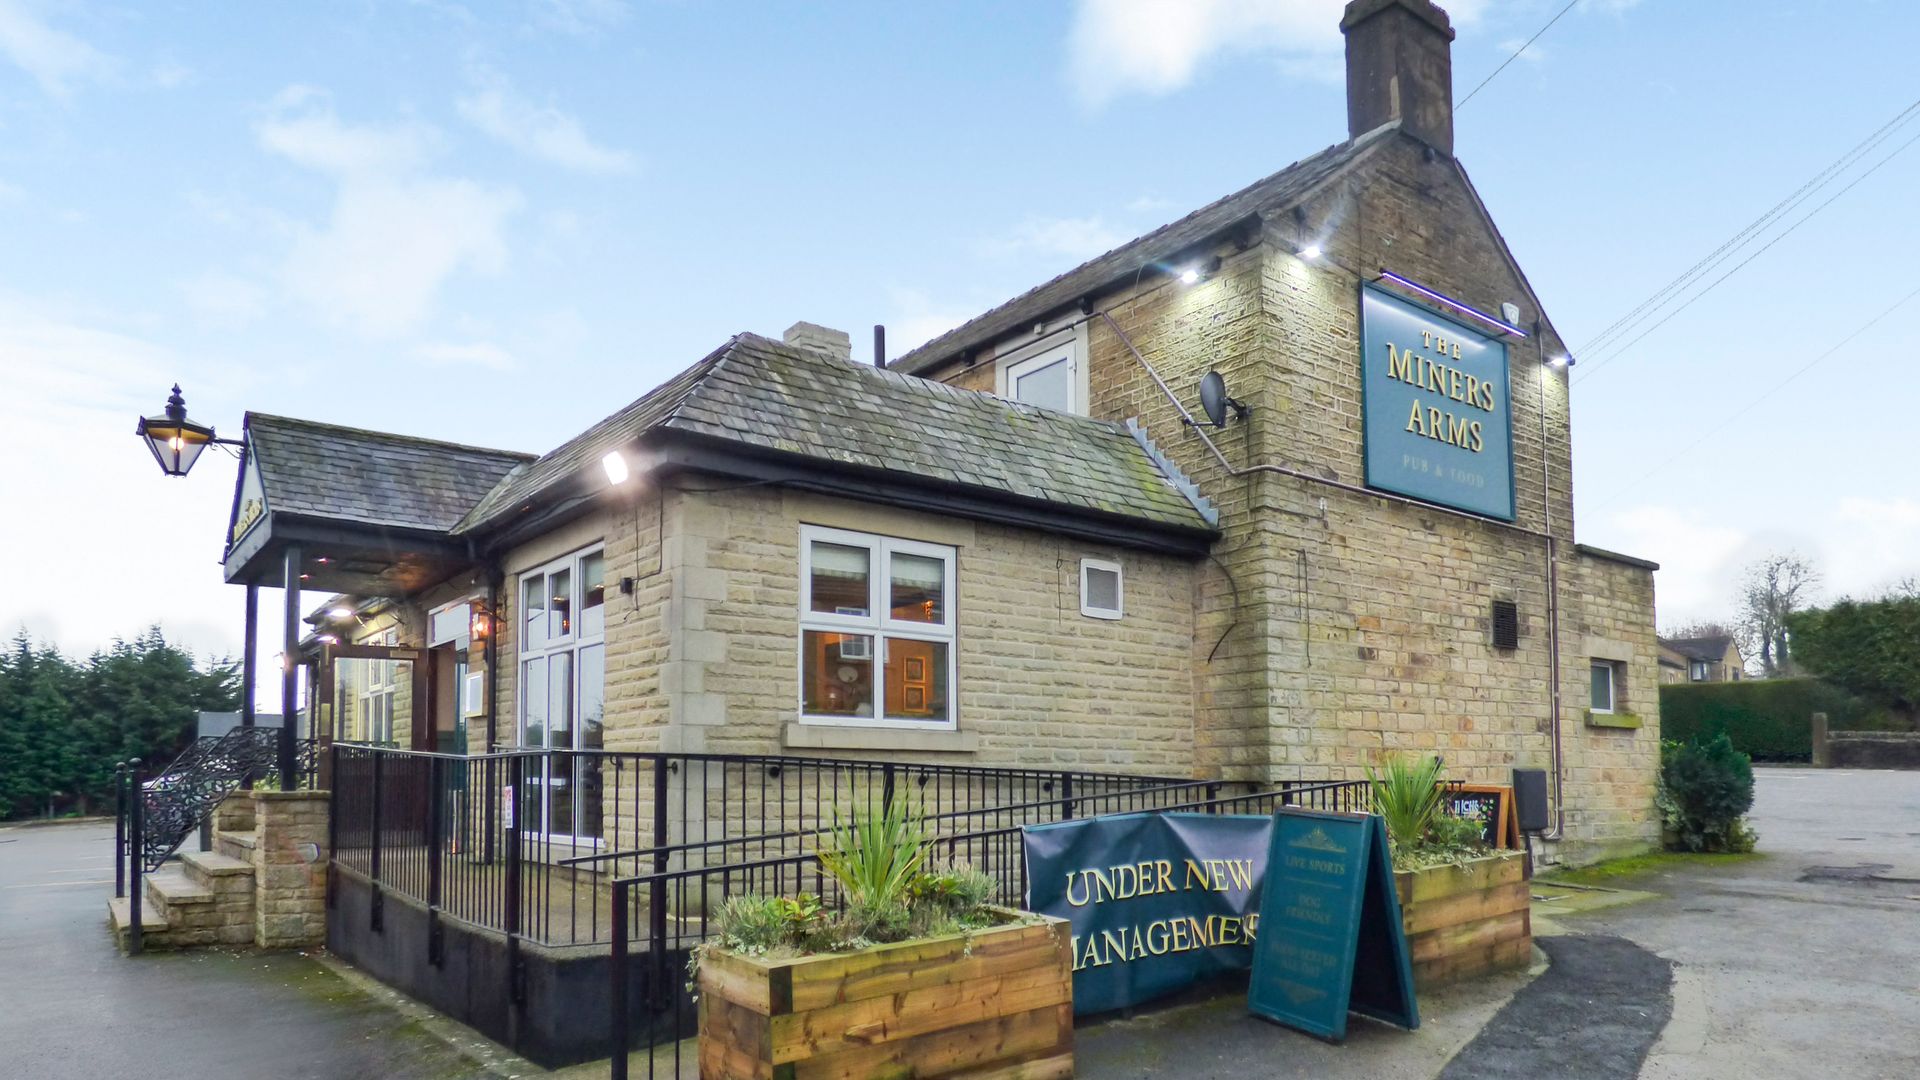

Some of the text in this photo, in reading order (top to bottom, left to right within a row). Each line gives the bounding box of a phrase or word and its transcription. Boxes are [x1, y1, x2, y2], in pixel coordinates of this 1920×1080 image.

[1422, 329, 1462, 360] THE
[1386, 342, 1495, 412] MINERS
[1405, 399, 1484, 453] ARMS
[1403, 454, 1485, 489] PUB & FOOD
[1066, 858, 1253, 907] UNDER NEW
[1284, 854, 1346, 876] LIVE SPORTS
